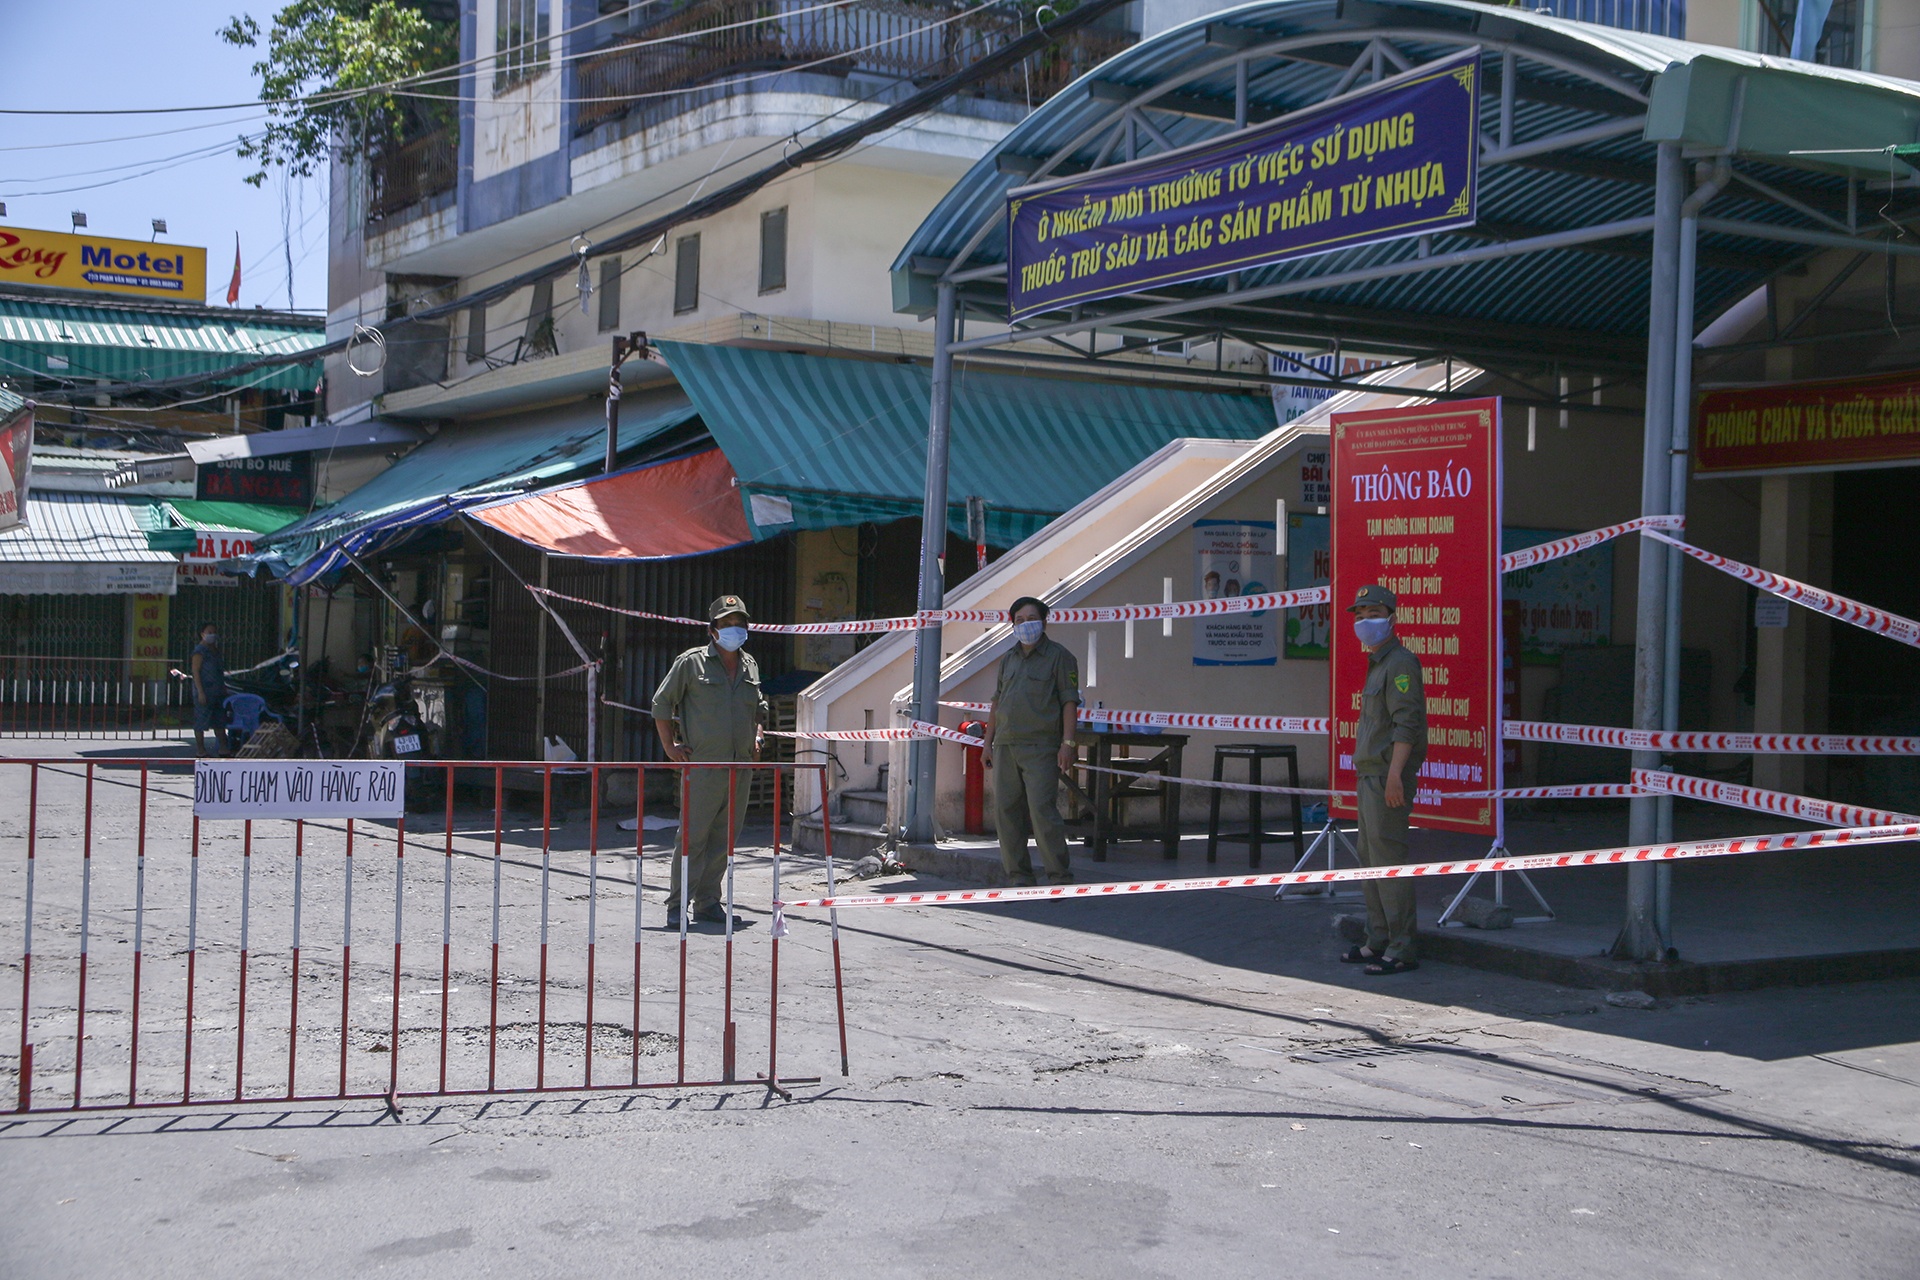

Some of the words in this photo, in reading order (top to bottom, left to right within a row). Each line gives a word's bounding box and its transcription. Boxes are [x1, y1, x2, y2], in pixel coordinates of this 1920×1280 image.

[1038, 210, 1049, 243] Ô
[1052, 194, 1106, 239] NHIỄM
[1108, 186, 1147, 223] MÔI
[1148, 168, 1223, 213] TRƯỜNG
[1229, 153, 1258, 192] TỪ
[1258, 142, 1304, 185] VIỆC
[1311, 123, 1345, 169] SỬ
[1348, 112, 1414, 162] DỤNG
[1021, 247, 1067, 293] THUỐC
[1071, 241, 1105, 279] TRỪ
[1105, 235, 1142, 271] SÂU
[1146, 224, 1169, 261] VÀ
[1174, 216, 1213, 255] CÁC
[1218, 201, 1261, 245] SẢN
[1267, 181, 1333, 234] PHẨM
[1339, 174, 1372, 217] TỪ
[1375, 161, 1446, 209] NHỰA
[81, 244, 184, 275] Motel
[1705, 403, 1757, 449] PHÒNG
[1760, 399, 1801, 444] CHÁY
[1805, 397, 1826, 440] VÀ
[1830, 393, 1875, 439] CHỮA
[1880, 386, 1920, 435] CHÁ
[1307, 452, 1326, 465] CHỢ
[1302, 465, 1323, 482] BÃI
[1352, 464, 1422, 502] THÔNG
[1427, 459, 1472, 498] BÁO
[1304, 484, 1315, 492] XE
[1304, 493, 1315, 502] XE
[1367, 518, 1382, 540] TẠM
[1410, 517, 1427, 535] KINH
[1429, 516, 1454, 534] DOANH
[1381, 547, 1391, 569] TẠI
[1393, 546, 1408, 568] CHỢ
[1409, 543, 1423, 564] TÂN
[1425, 543, 1439, 568] LẬP
[1388, 577, 1397, 594] 16
[1398, 573, 1411, 594] GIỜ
[1412, 577, 1421, 594] 00
[1423, 573, 1442, 594] PHÚT
[1416, 607, 1421, 624] 8
[1423, 604, 1440, 624] NĂM
[1442, 607, 1460, 625] 2020
[1427, 633, 1443, 654] BÁO
[1444, 634, 1459, 654] MỚI
[1434, 664, 1449, 685] TÁC
[1352, 690, 1362, 710] XÉ
[1426, 691, 1452, 715] KHUẨN
[1454, 697, 1470, 720] CHỢ
[1471, 762, 1482, 782] TÁC
[240, 770, 278, 806] CHẠM
[285, 766, 313, 802] VÀO
[321, 764, 361, 802] HÀNG
[368, 765, 396, 801] RÀO
